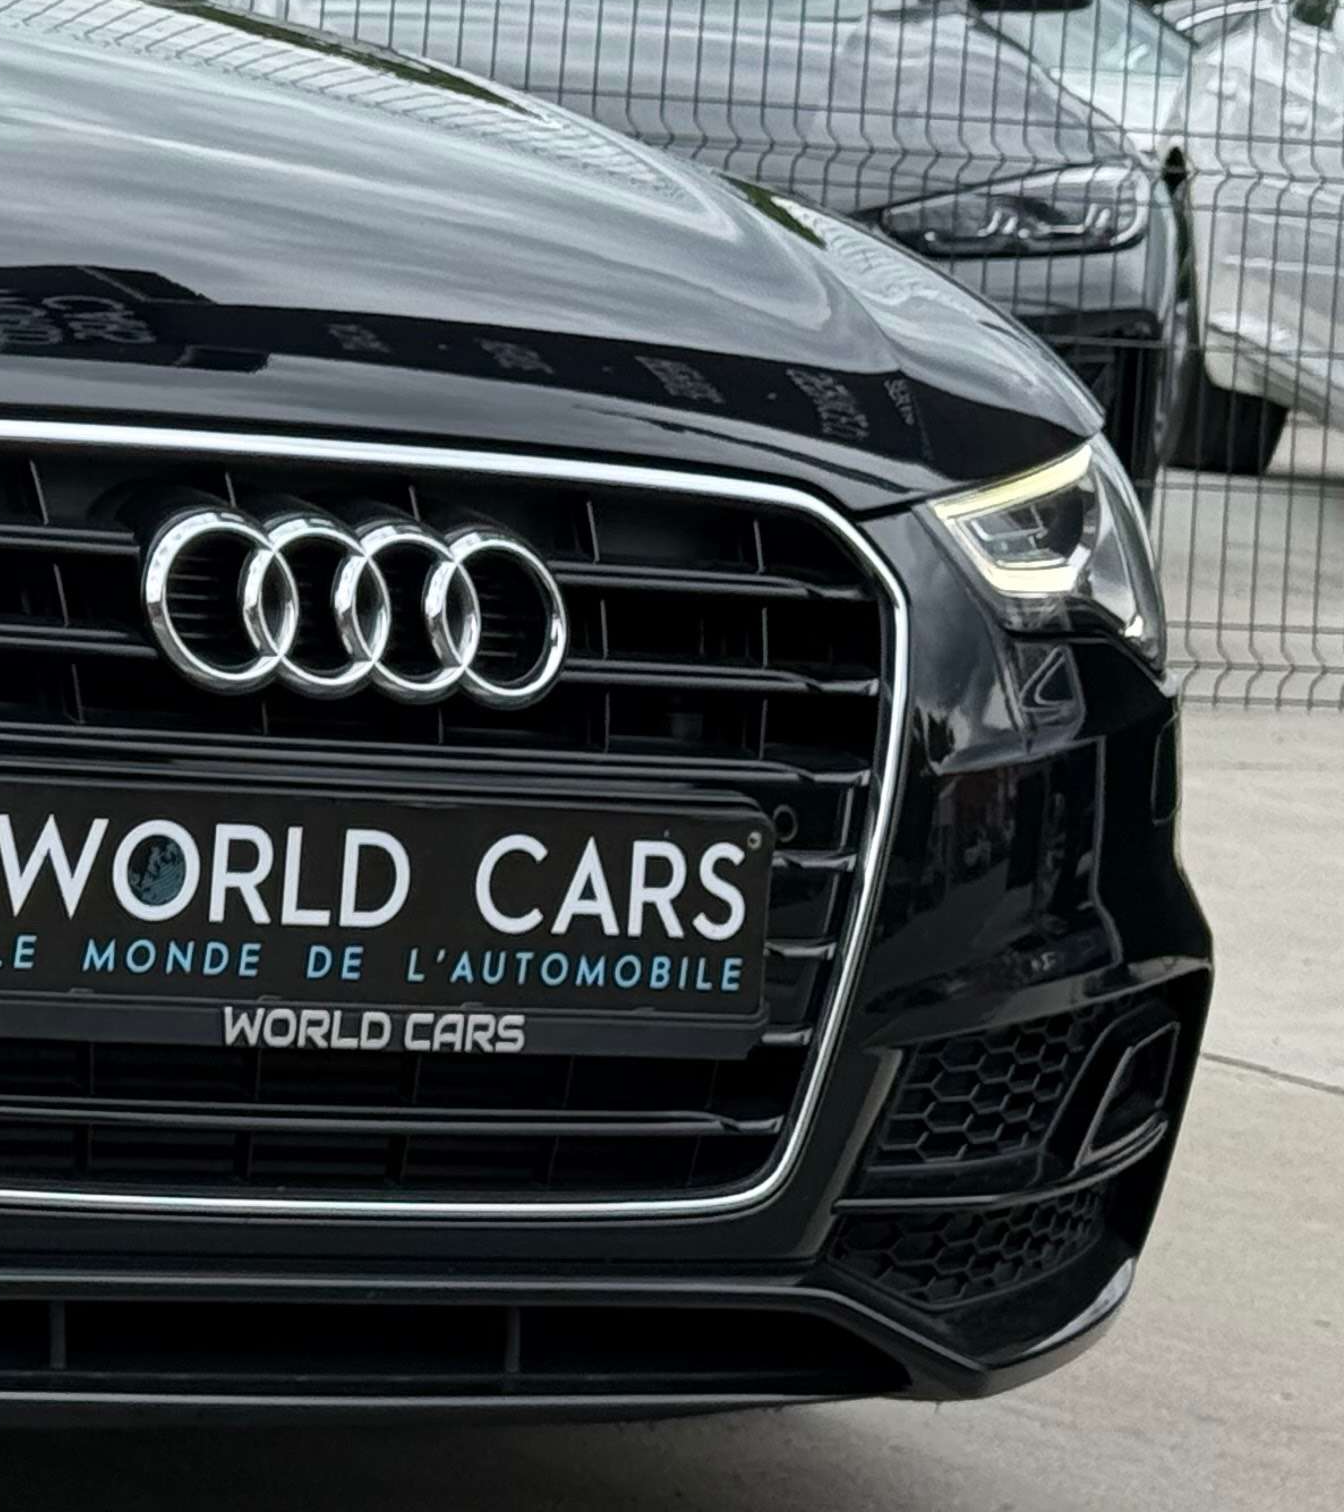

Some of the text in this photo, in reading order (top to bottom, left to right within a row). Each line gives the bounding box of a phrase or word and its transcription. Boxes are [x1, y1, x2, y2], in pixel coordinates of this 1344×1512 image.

[474, 833, 747, 942] CARS
[81, 938, 262, 978] MONDE
[305, 944, 365, 981] DE
[406, 947, 743, 992] L'AUTOMOBILE
[222, 1005, 526, 1053] WORLD CARS
